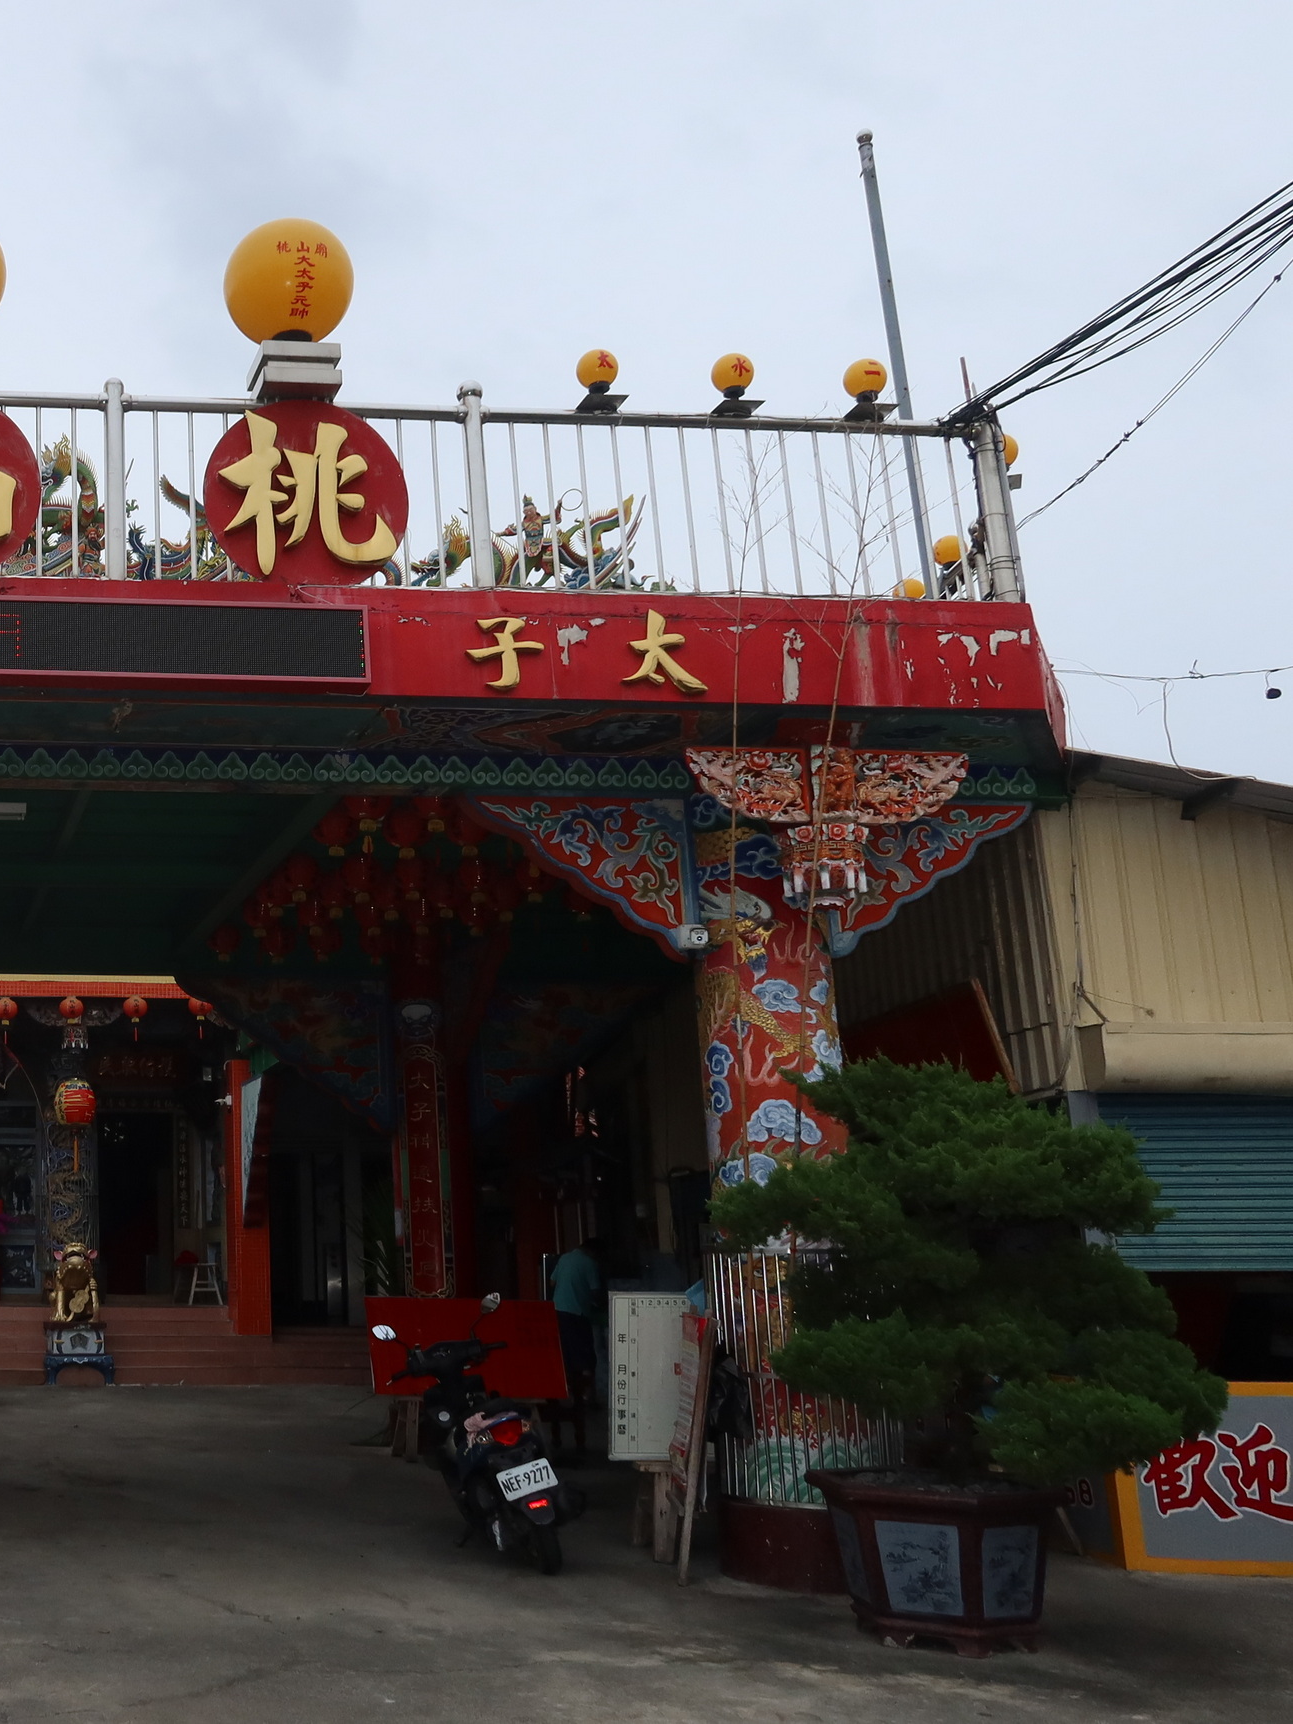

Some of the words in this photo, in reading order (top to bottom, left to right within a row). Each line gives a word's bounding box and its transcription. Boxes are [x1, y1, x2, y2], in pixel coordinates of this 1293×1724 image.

[276, 241, 328, 258] 桃山廟
[290, 255, 315, 319] 大太子元帥
[597, 351, 614, 369] 太
[731, 358, 751, 377] 水
